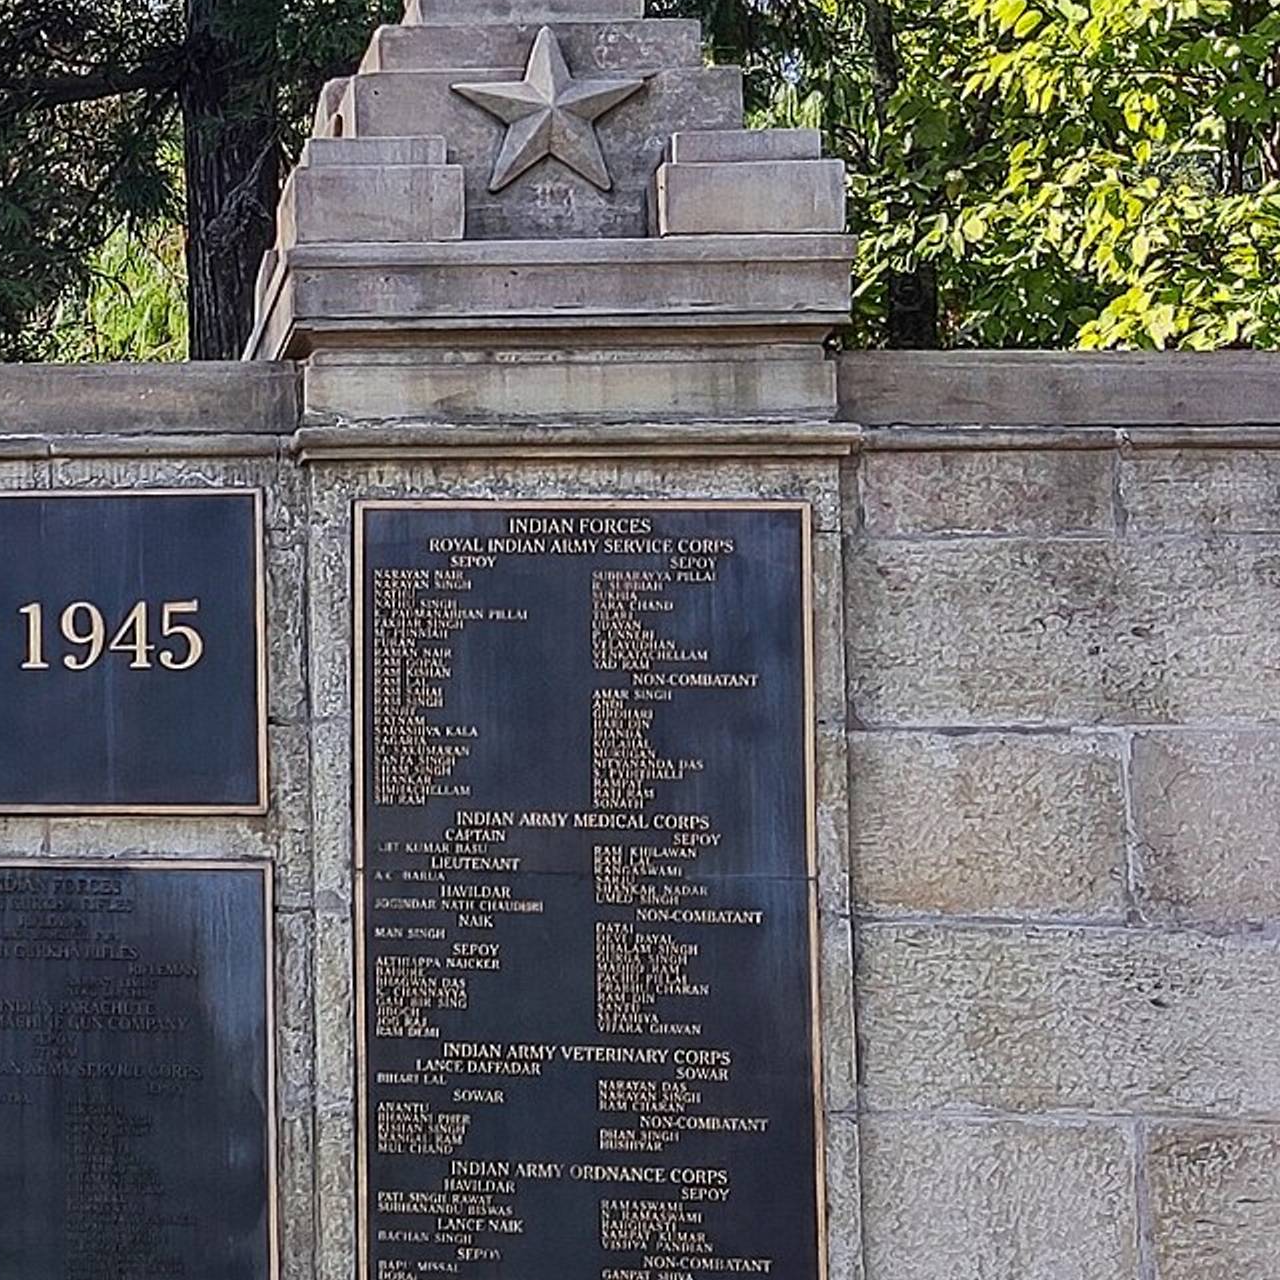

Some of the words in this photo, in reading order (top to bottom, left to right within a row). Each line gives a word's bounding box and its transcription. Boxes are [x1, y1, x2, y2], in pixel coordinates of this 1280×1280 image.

[510, 519, 573, 533] INDIAN
[580, 519, 651, 533] FORCES
[430, 539, 483, 552] ROYAL
[489, 539, 544, 552] INDIAN
[551, 539, 598, 553] ARMY
[604, 539, 672, 553] SERVICE
[678, 540, 733, 553] CORPS
[451, 556, 496, 567] SEPOY
[670, 557, 716, 569] SEPOY
[20, 600, 202, 669] 1945
[633, 674, 758, 687] NON-COMBATANT
[458, 812, 514, 826] INDIAN
[519, 813, 568, 827] ARMY
[574, 814, 649, 828] MEDICAL
[654, 815, 709, 829] CORPS
[446, 829, 505, 841] CAPTAIN
[432, 857, 520, 870] LIEUTENANT
[442, 885, 510, 898] HAVILDAR
[459, 915, 493, 927] NAIK
[637, 909, 762, 923] NON-COMBATANT
[444, 1043, 501, 1061] INDIAN
[507, 1045, 556, 1060] ARMY
[561, 1046, 668, 1063] VETERINARY
[674, 1050, 730, 1065] CORPS
[417, 1059, 463, 1073] LANCE
[468, 1061, 540, 1074] DAFFADAR
[676, 1067, 728, 1080] SOWAR
[453, 1090, 503, 1102] SOWAR
[451, 1161, 509, 1180] INDIAN
[515, 1164, 564, 1179] ARMY
[570, 1165, 666, 1182] ORDNANCE
[670, 1169, 727, 1184] CORPS
[438, 1218, 484, 1231] LANCE
[489, 1219, 523, 1232] NAIK
